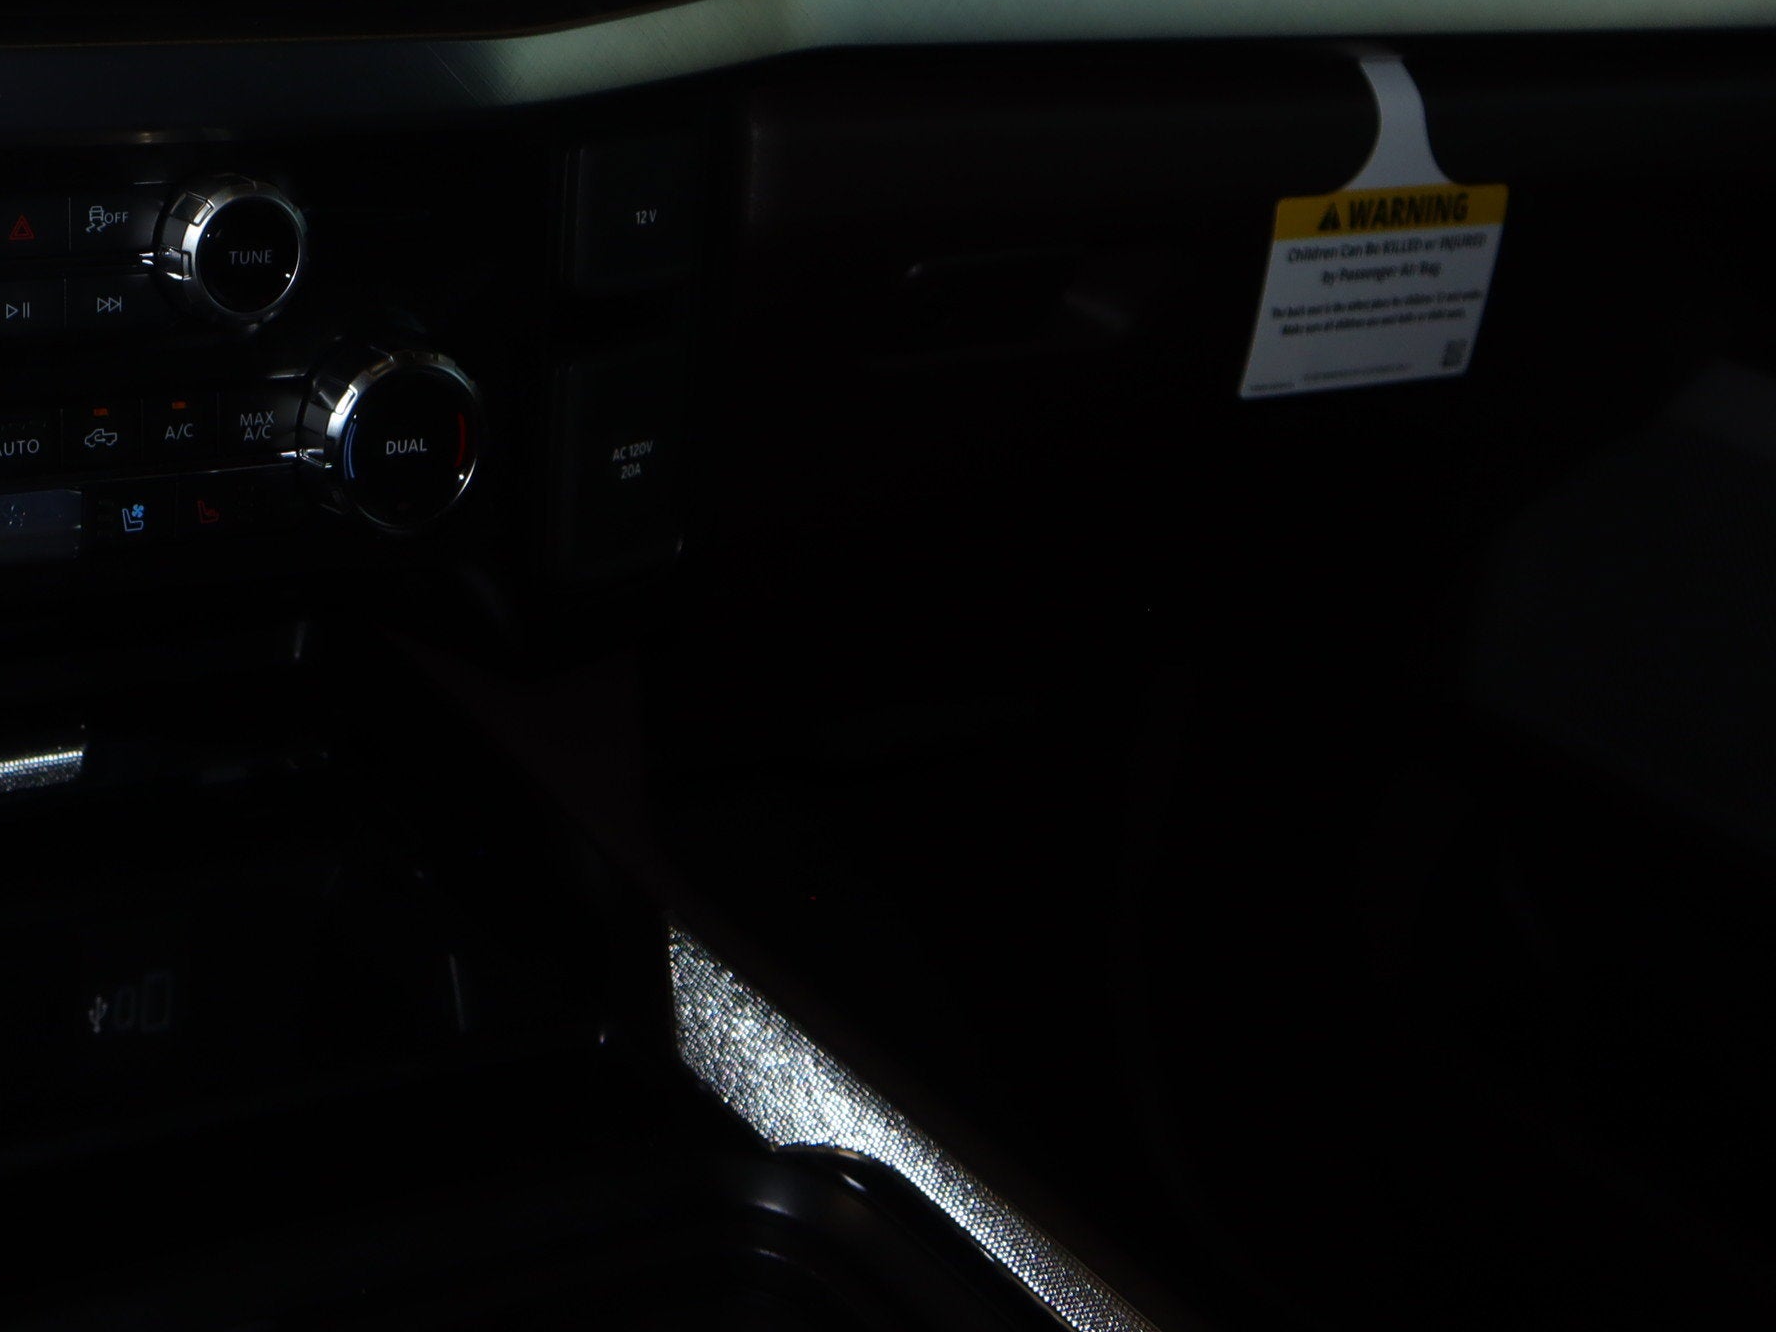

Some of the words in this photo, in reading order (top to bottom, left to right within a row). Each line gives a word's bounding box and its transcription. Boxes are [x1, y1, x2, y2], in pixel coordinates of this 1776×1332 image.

[104, 211, 129, 224] OFF
[1348, 193, 1470, 229] WARNING
[228, 248, 273, 267] TUNE
[239, 410, 275, 427] MAX
[164, 423, 194, 440] A/C
[243, 424, 272, 442] A/C
[385, 438, 429, 456] DUAL
